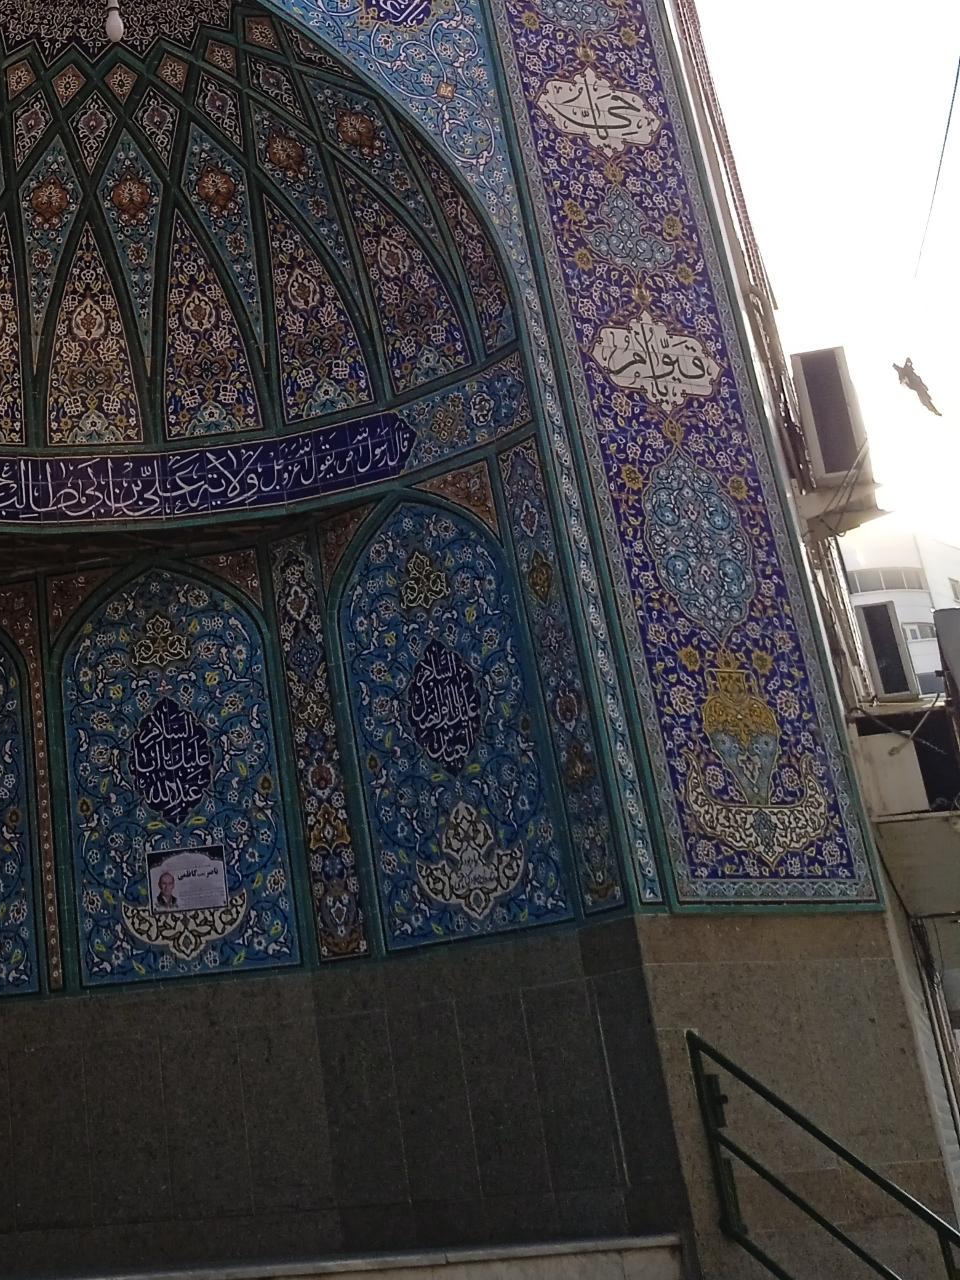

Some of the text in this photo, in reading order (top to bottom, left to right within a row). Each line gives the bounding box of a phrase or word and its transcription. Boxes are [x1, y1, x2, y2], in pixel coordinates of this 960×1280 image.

[356, 436, 388, 473] رسول
[386, 422, 410, 467] قال
[139, 707, 194, 745] السلام
[163, 739, 211, 771] علیک
